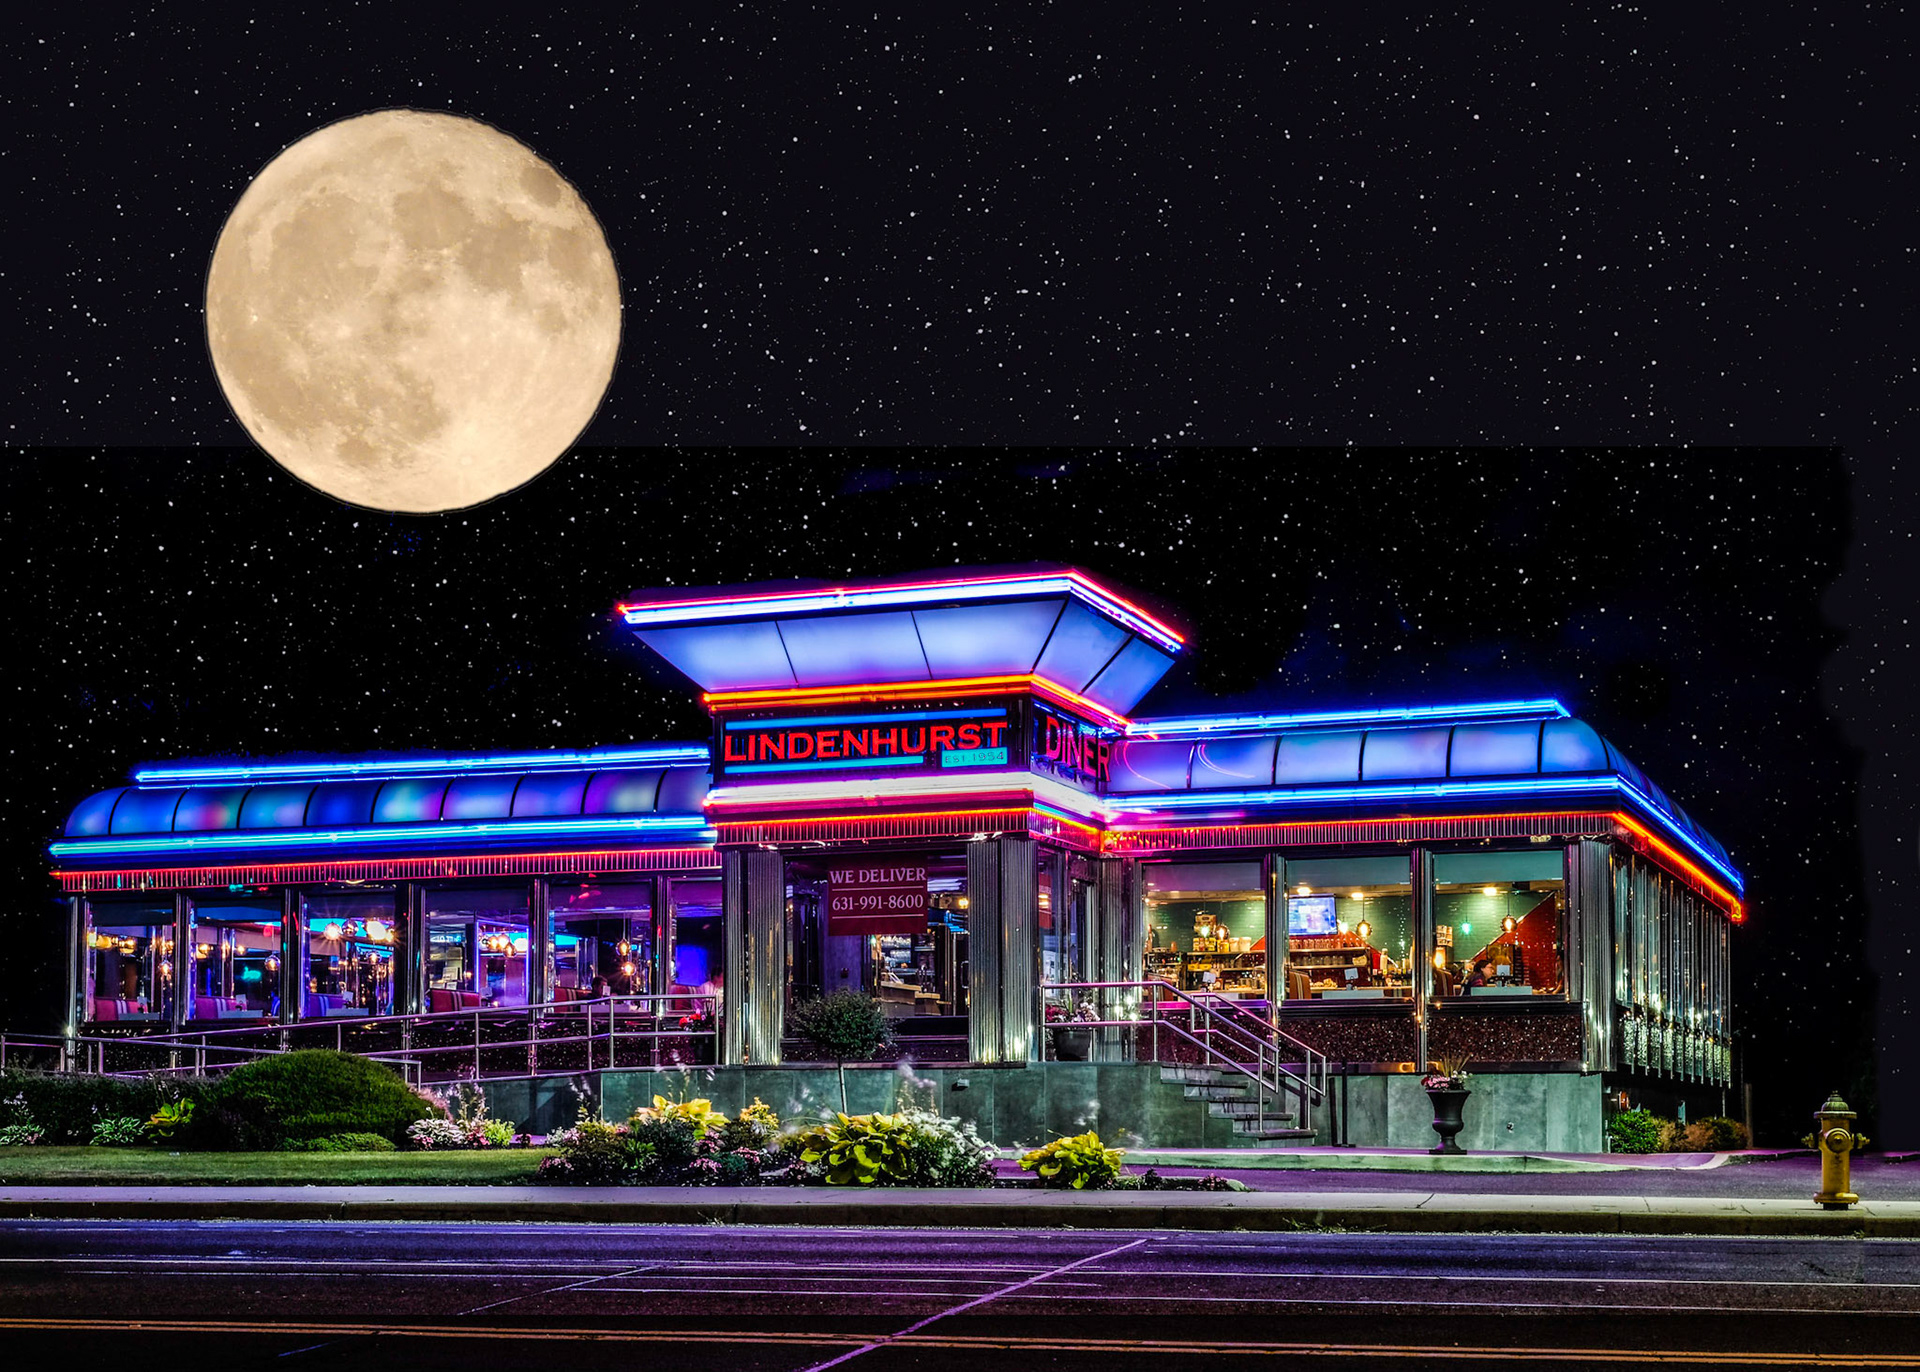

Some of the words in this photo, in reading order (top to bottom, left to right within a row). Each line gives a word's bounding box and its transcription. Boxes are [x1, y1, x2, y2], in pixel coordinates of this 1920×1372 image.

[724, 722, 1008, 761] LINDENHURST
[1045, 714, 1111, 782] DINER
[829, 870, 855, 884] WE
[859, 867, 926, 883] DELIVER
[832, 894, 924, 911] 631-991-8600
